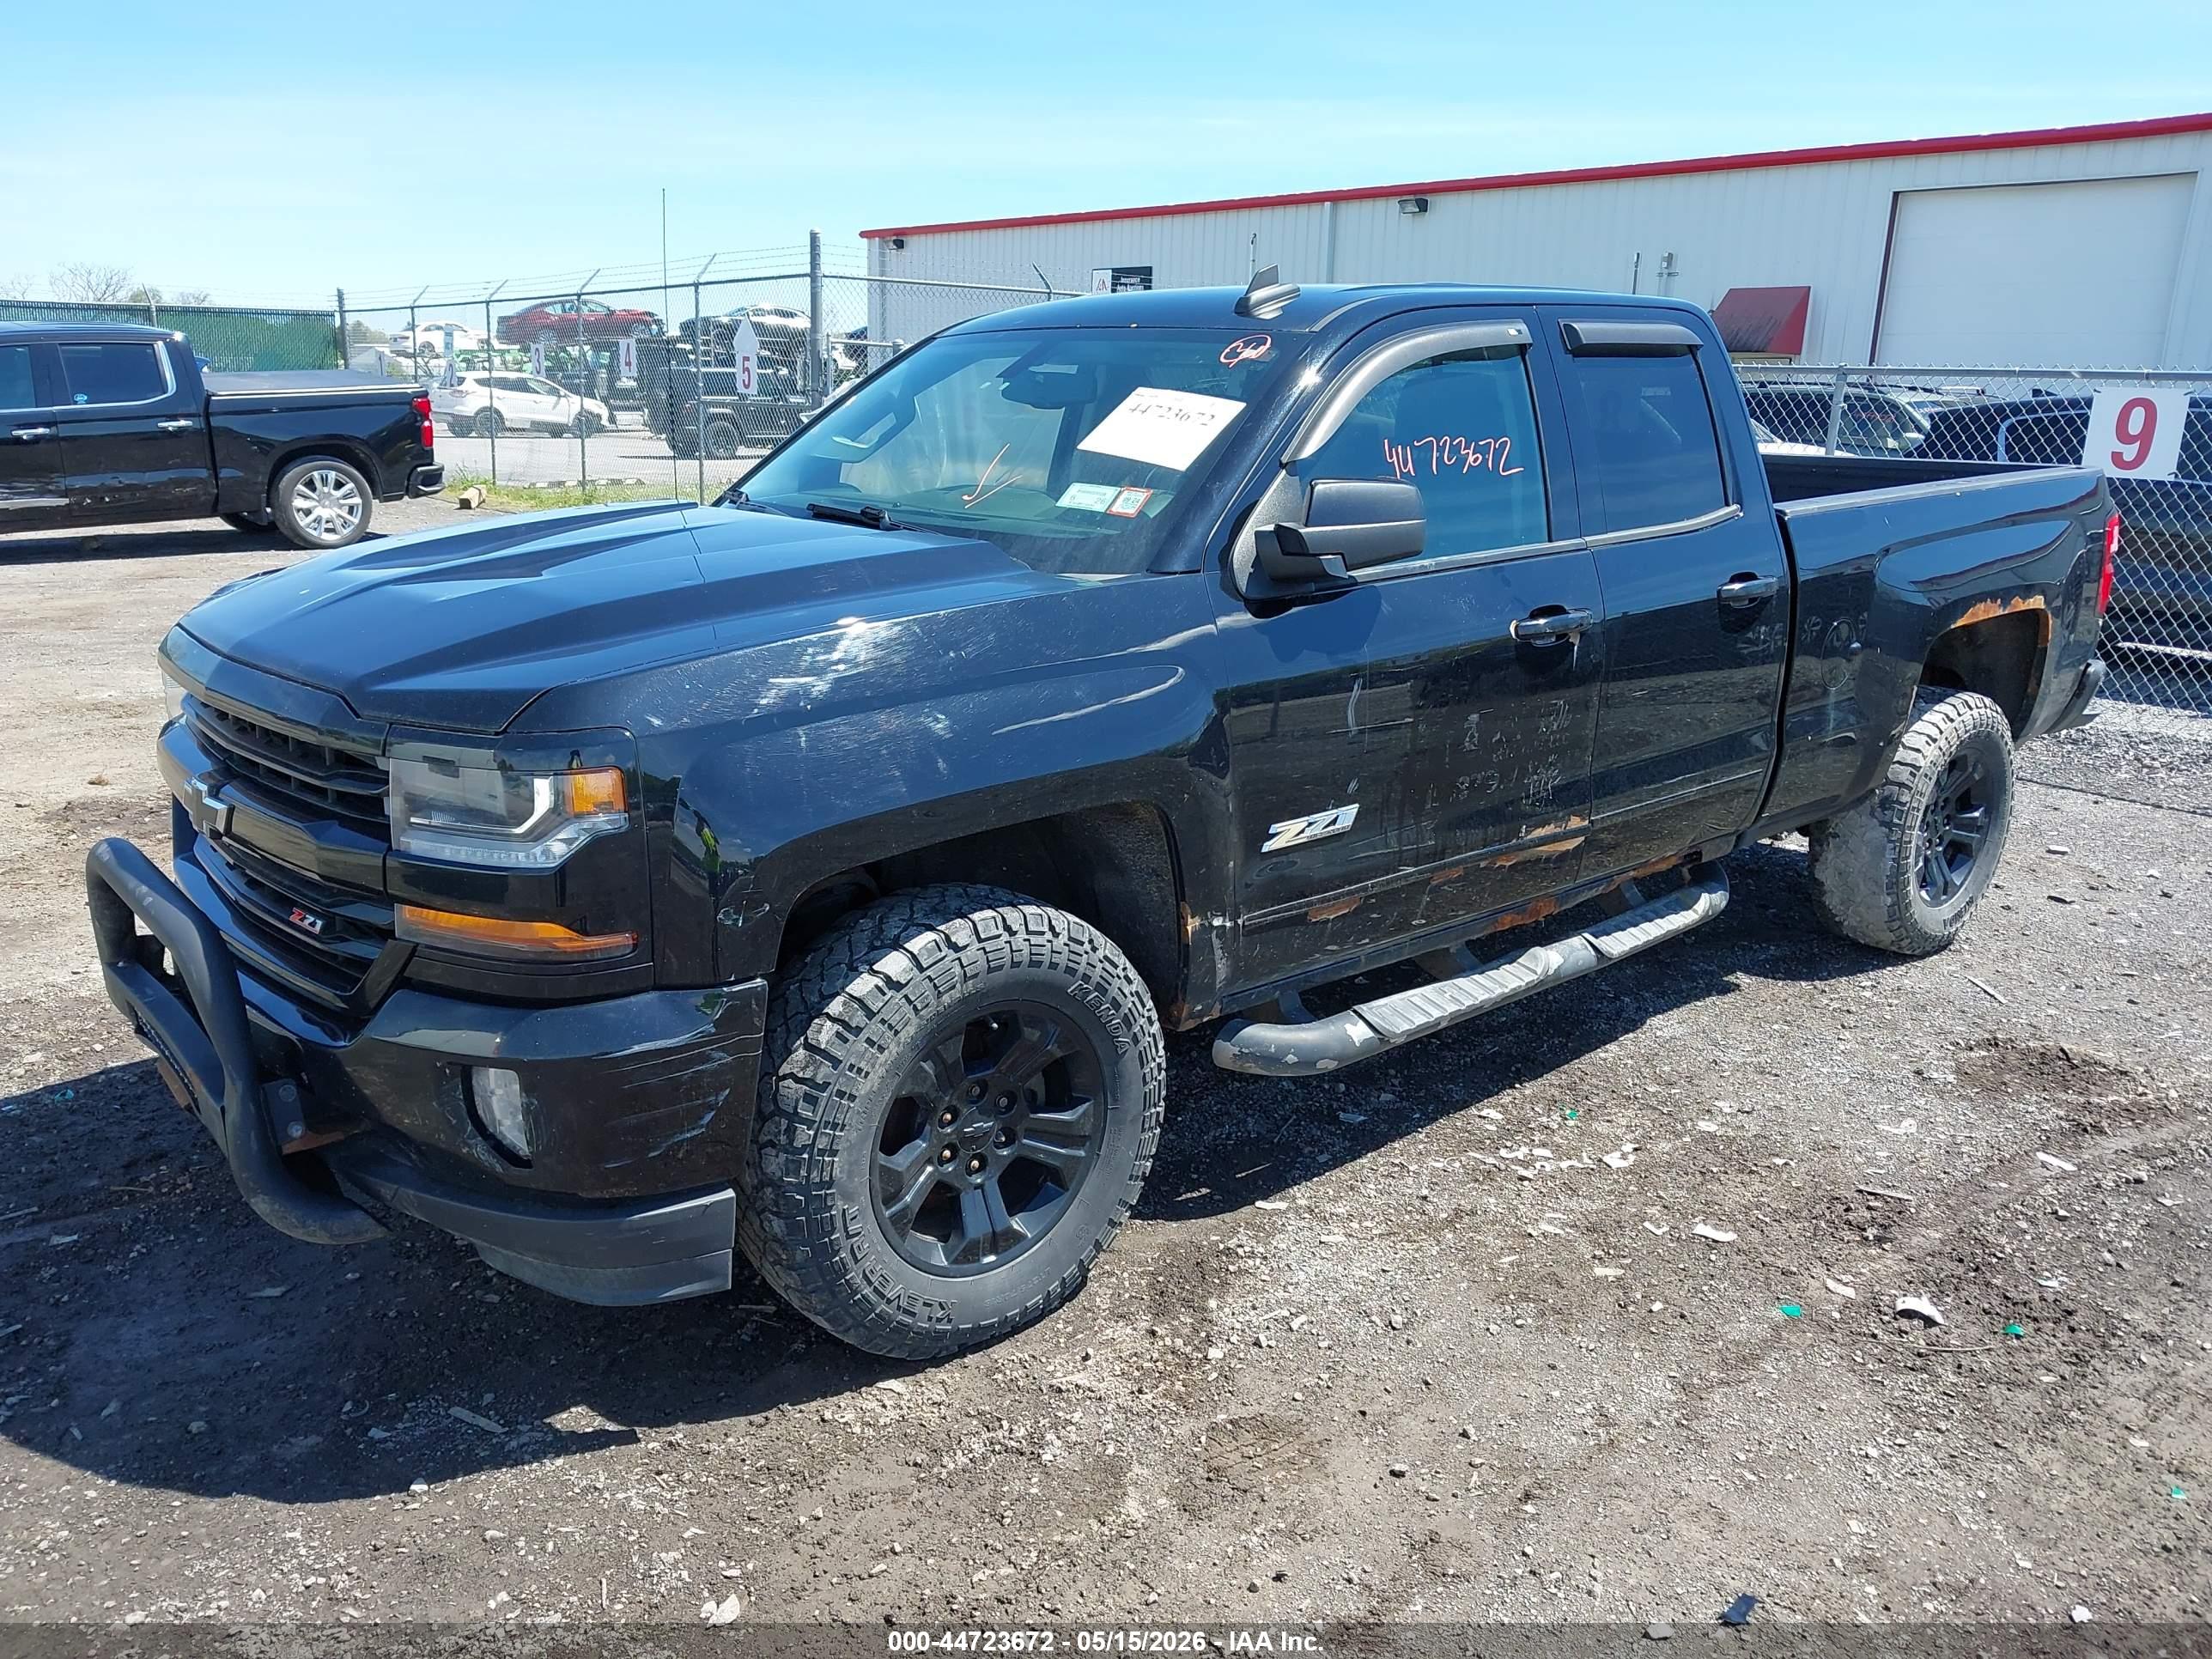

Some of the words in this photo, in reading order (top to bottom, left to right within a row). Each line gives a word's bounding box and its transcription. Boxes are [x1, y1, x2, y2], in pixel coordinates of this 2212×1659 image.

[378, 354, 384, 376] 1
[534, 347, 542, 376] 3
[624, 343, 632, 373] 4
[742, 356, 751, 390] 5
[2110, 397, 2158, 471] 9
[1384, 436, 1525, 480] 44723672
[1261, 803, 1360, 854] Z71
[289, 907, 323, 935] Z71
[1066, 980, 1132, 1055] KENDA
[861, 1255, 958, 1324] KLEVER
